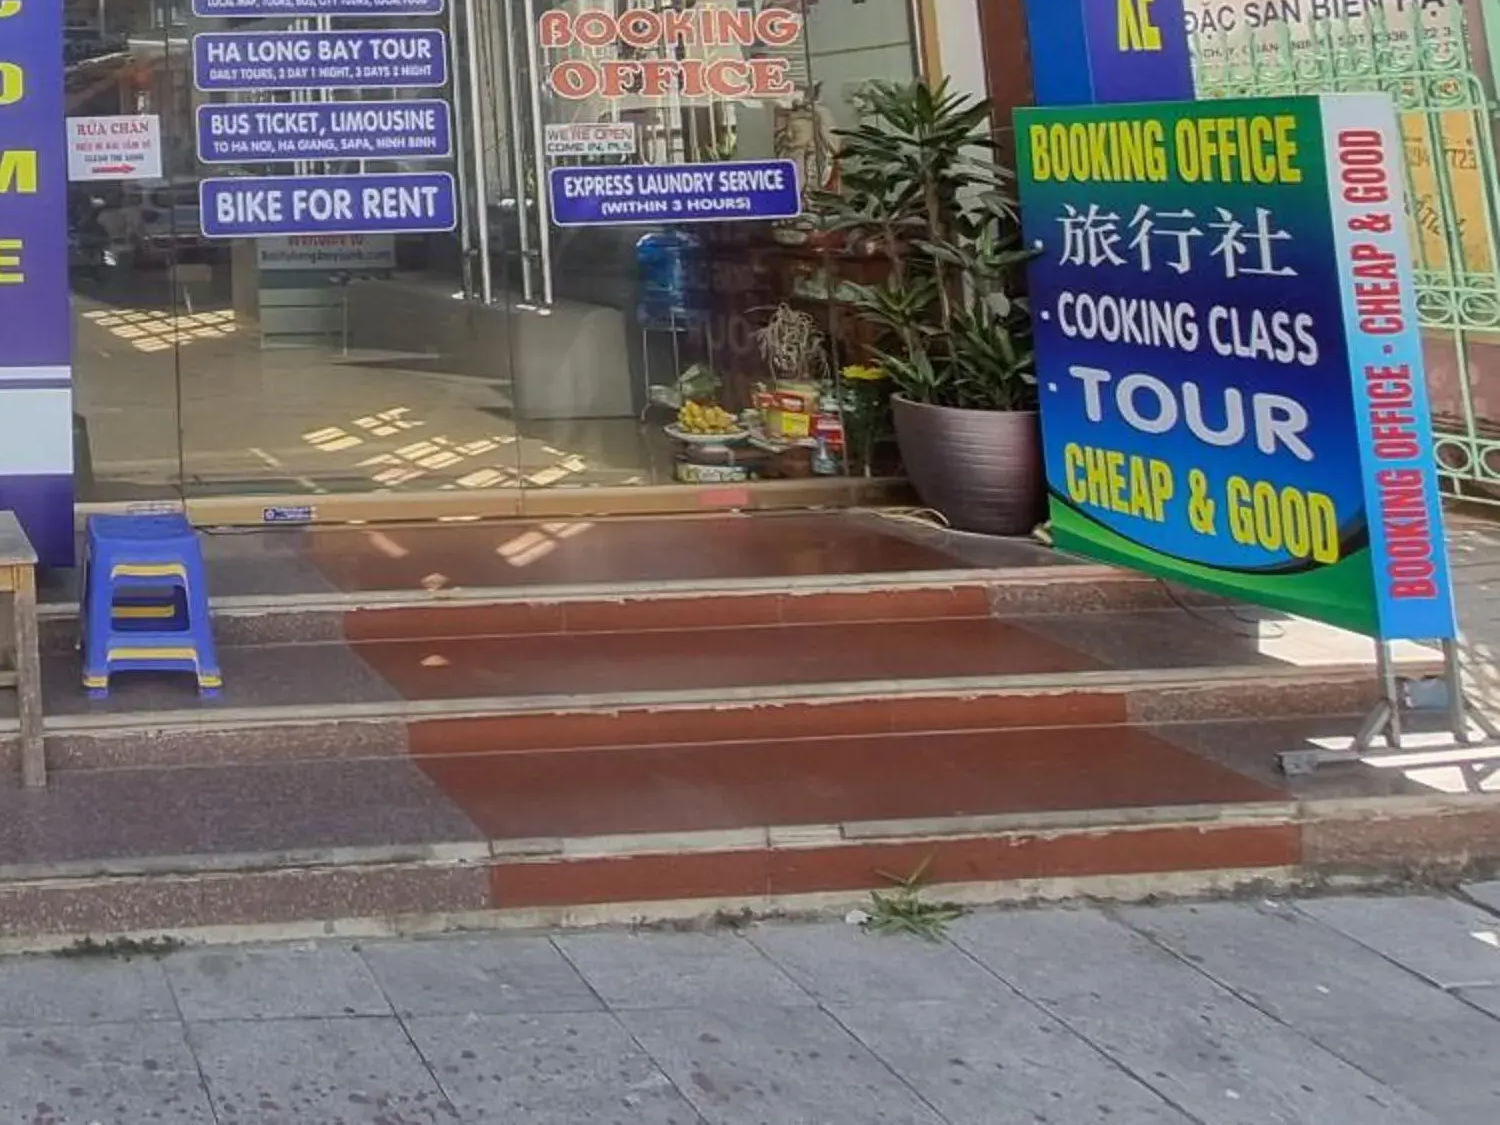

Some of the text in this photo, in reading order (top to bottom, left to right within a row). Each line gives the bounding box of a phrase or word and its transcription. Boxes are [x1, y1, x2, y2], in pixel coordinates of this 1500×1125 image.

[207, 38, 432, 63] HA LONG BAY TOUR
[540, 8, 802, 47] BOOKING
[551, 59, 794, 100] OFFICE
[211, 109, 436, 137] BUS TICKET, LIMOUSINE
[595, 128, 633, 140] OPEN
[1029, 115, 1302, 184] BOOKING OFFICE
[563, 169, 784, 198] EXPRESS LAUNDRY SERVICE
[1336, 129, 1389, 205] GOOD
[216, 186, 439, 223] BIKE FOR RENT
[673, 200, 683, 212] 3
[1055, 202, 1298, 278] 旅行社
[1349, 243, 1403, 336] CHEAP
[1058, 290, 1320, 367] COOKING CLASS
[1069, 365, 1315, 463] TOUR
[1365, 363, 1421, 460] OFFICE
[1064, 442, 1340, 565] CHEAP & GOOD
[1376, 468, 1438, 600] BOOKING
